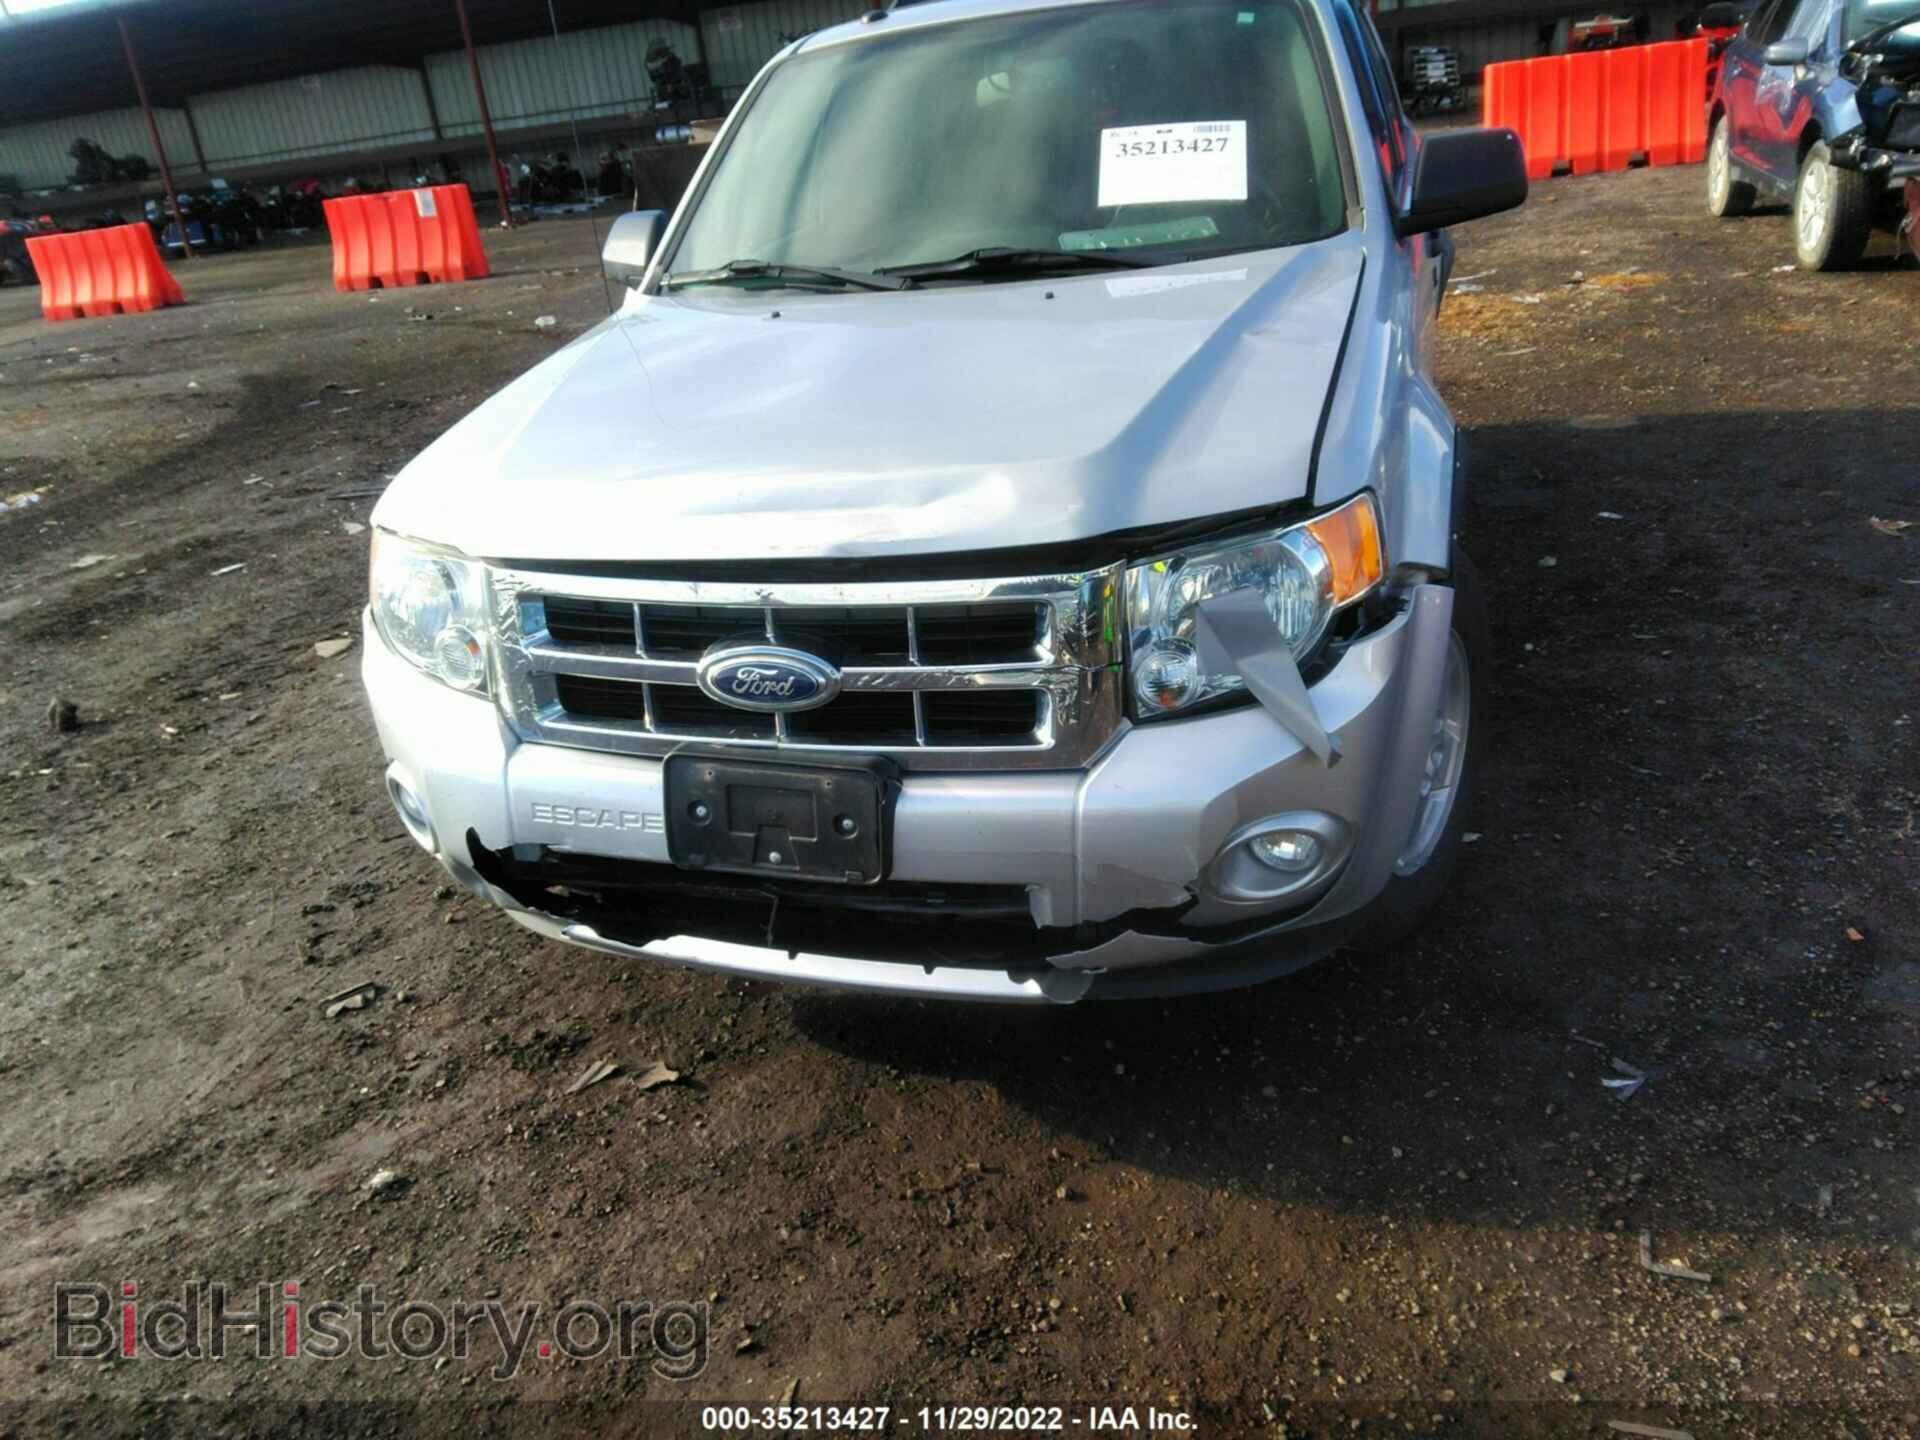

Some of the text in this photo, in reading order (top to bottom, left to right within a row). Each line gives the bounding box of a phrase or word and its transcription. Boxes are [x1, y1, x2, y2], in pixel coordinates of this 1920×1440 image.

[1115, 137, 1229, 158] 35213427
[731, 666, 796, 696] Ford
[531, 802, 664, 833] ESCAPE
